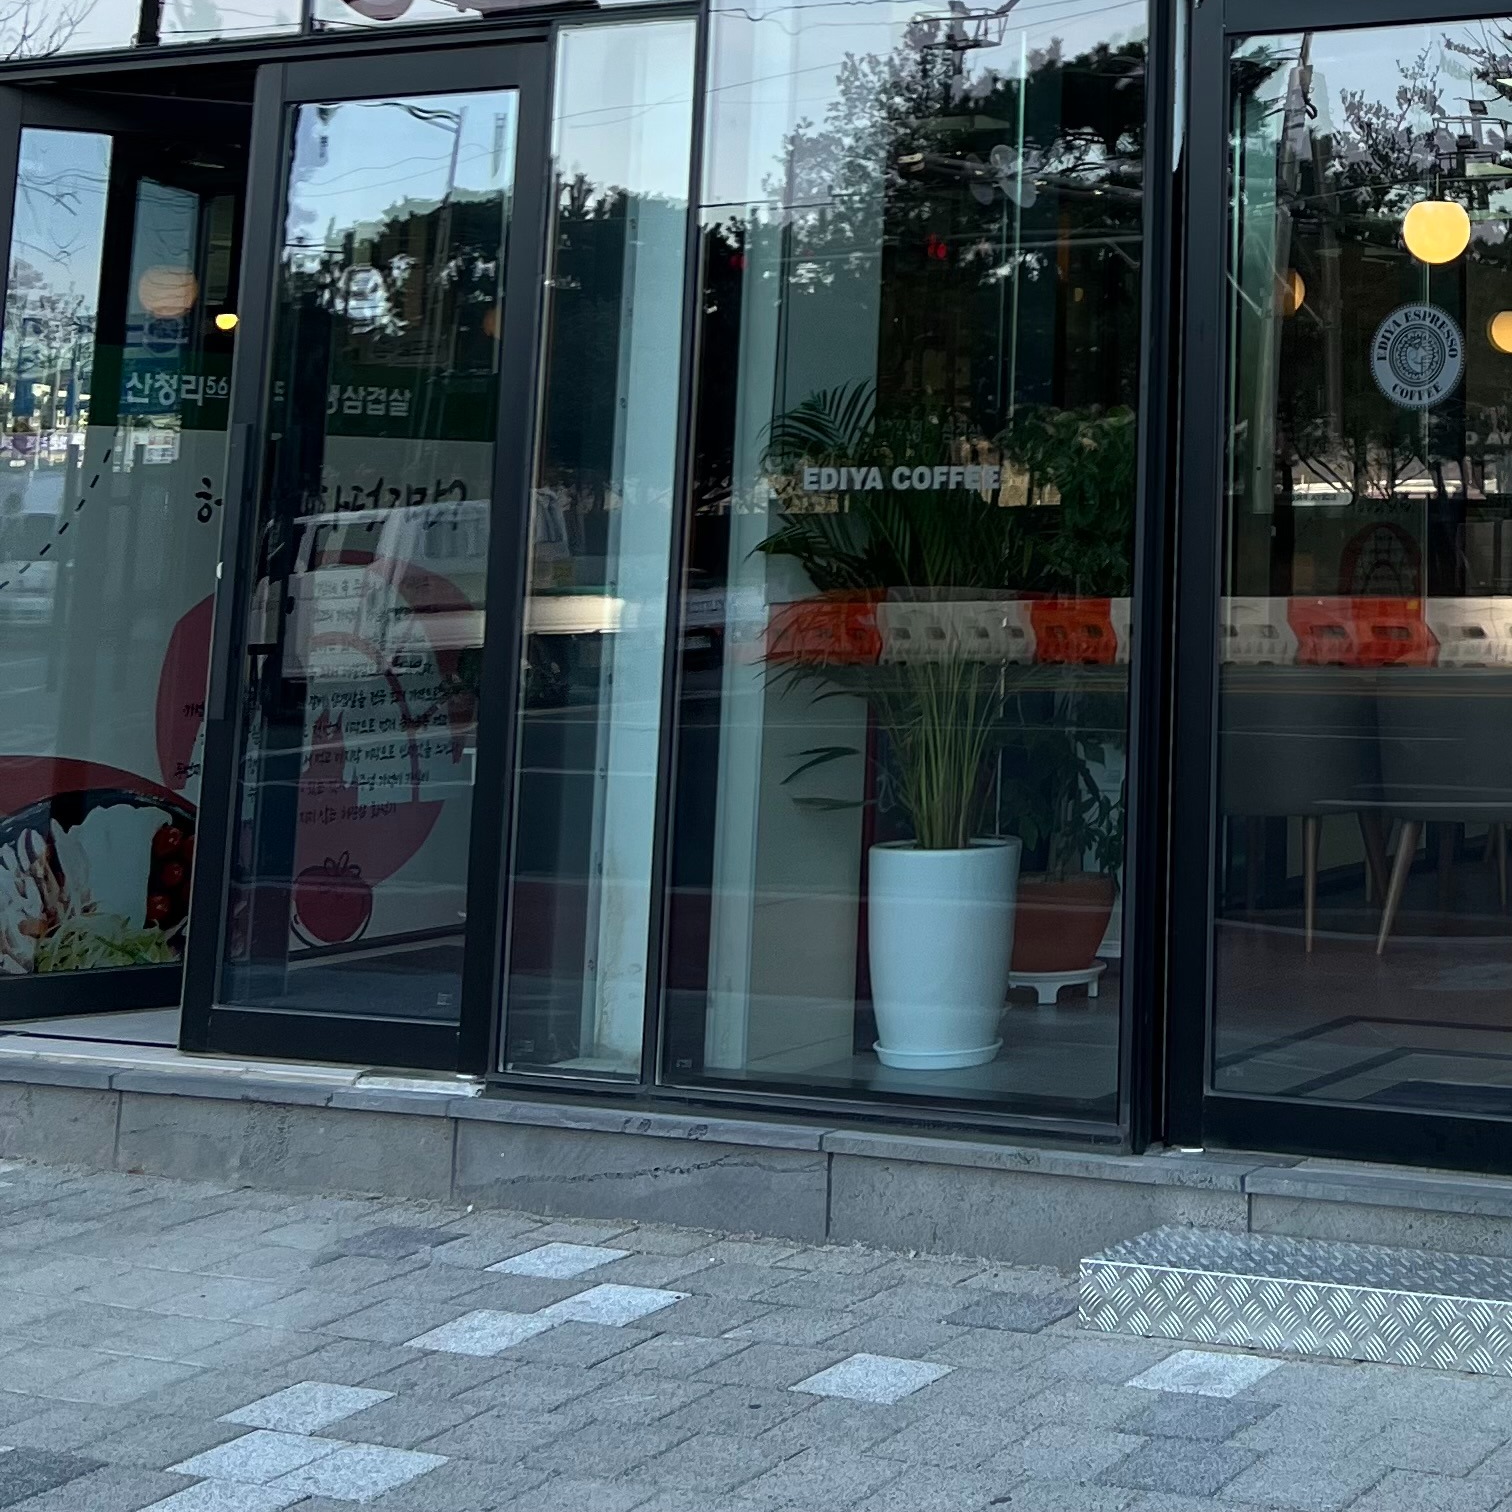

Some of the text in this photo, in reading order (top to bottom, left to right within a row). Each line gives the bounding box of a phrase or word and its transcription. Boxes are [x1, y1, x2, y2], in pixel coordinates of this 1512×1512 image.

[1376, 310, 1459, 361] EDIYA ESPRESSO
[802, 465, 1000, 492] EDIYA COFFEE
